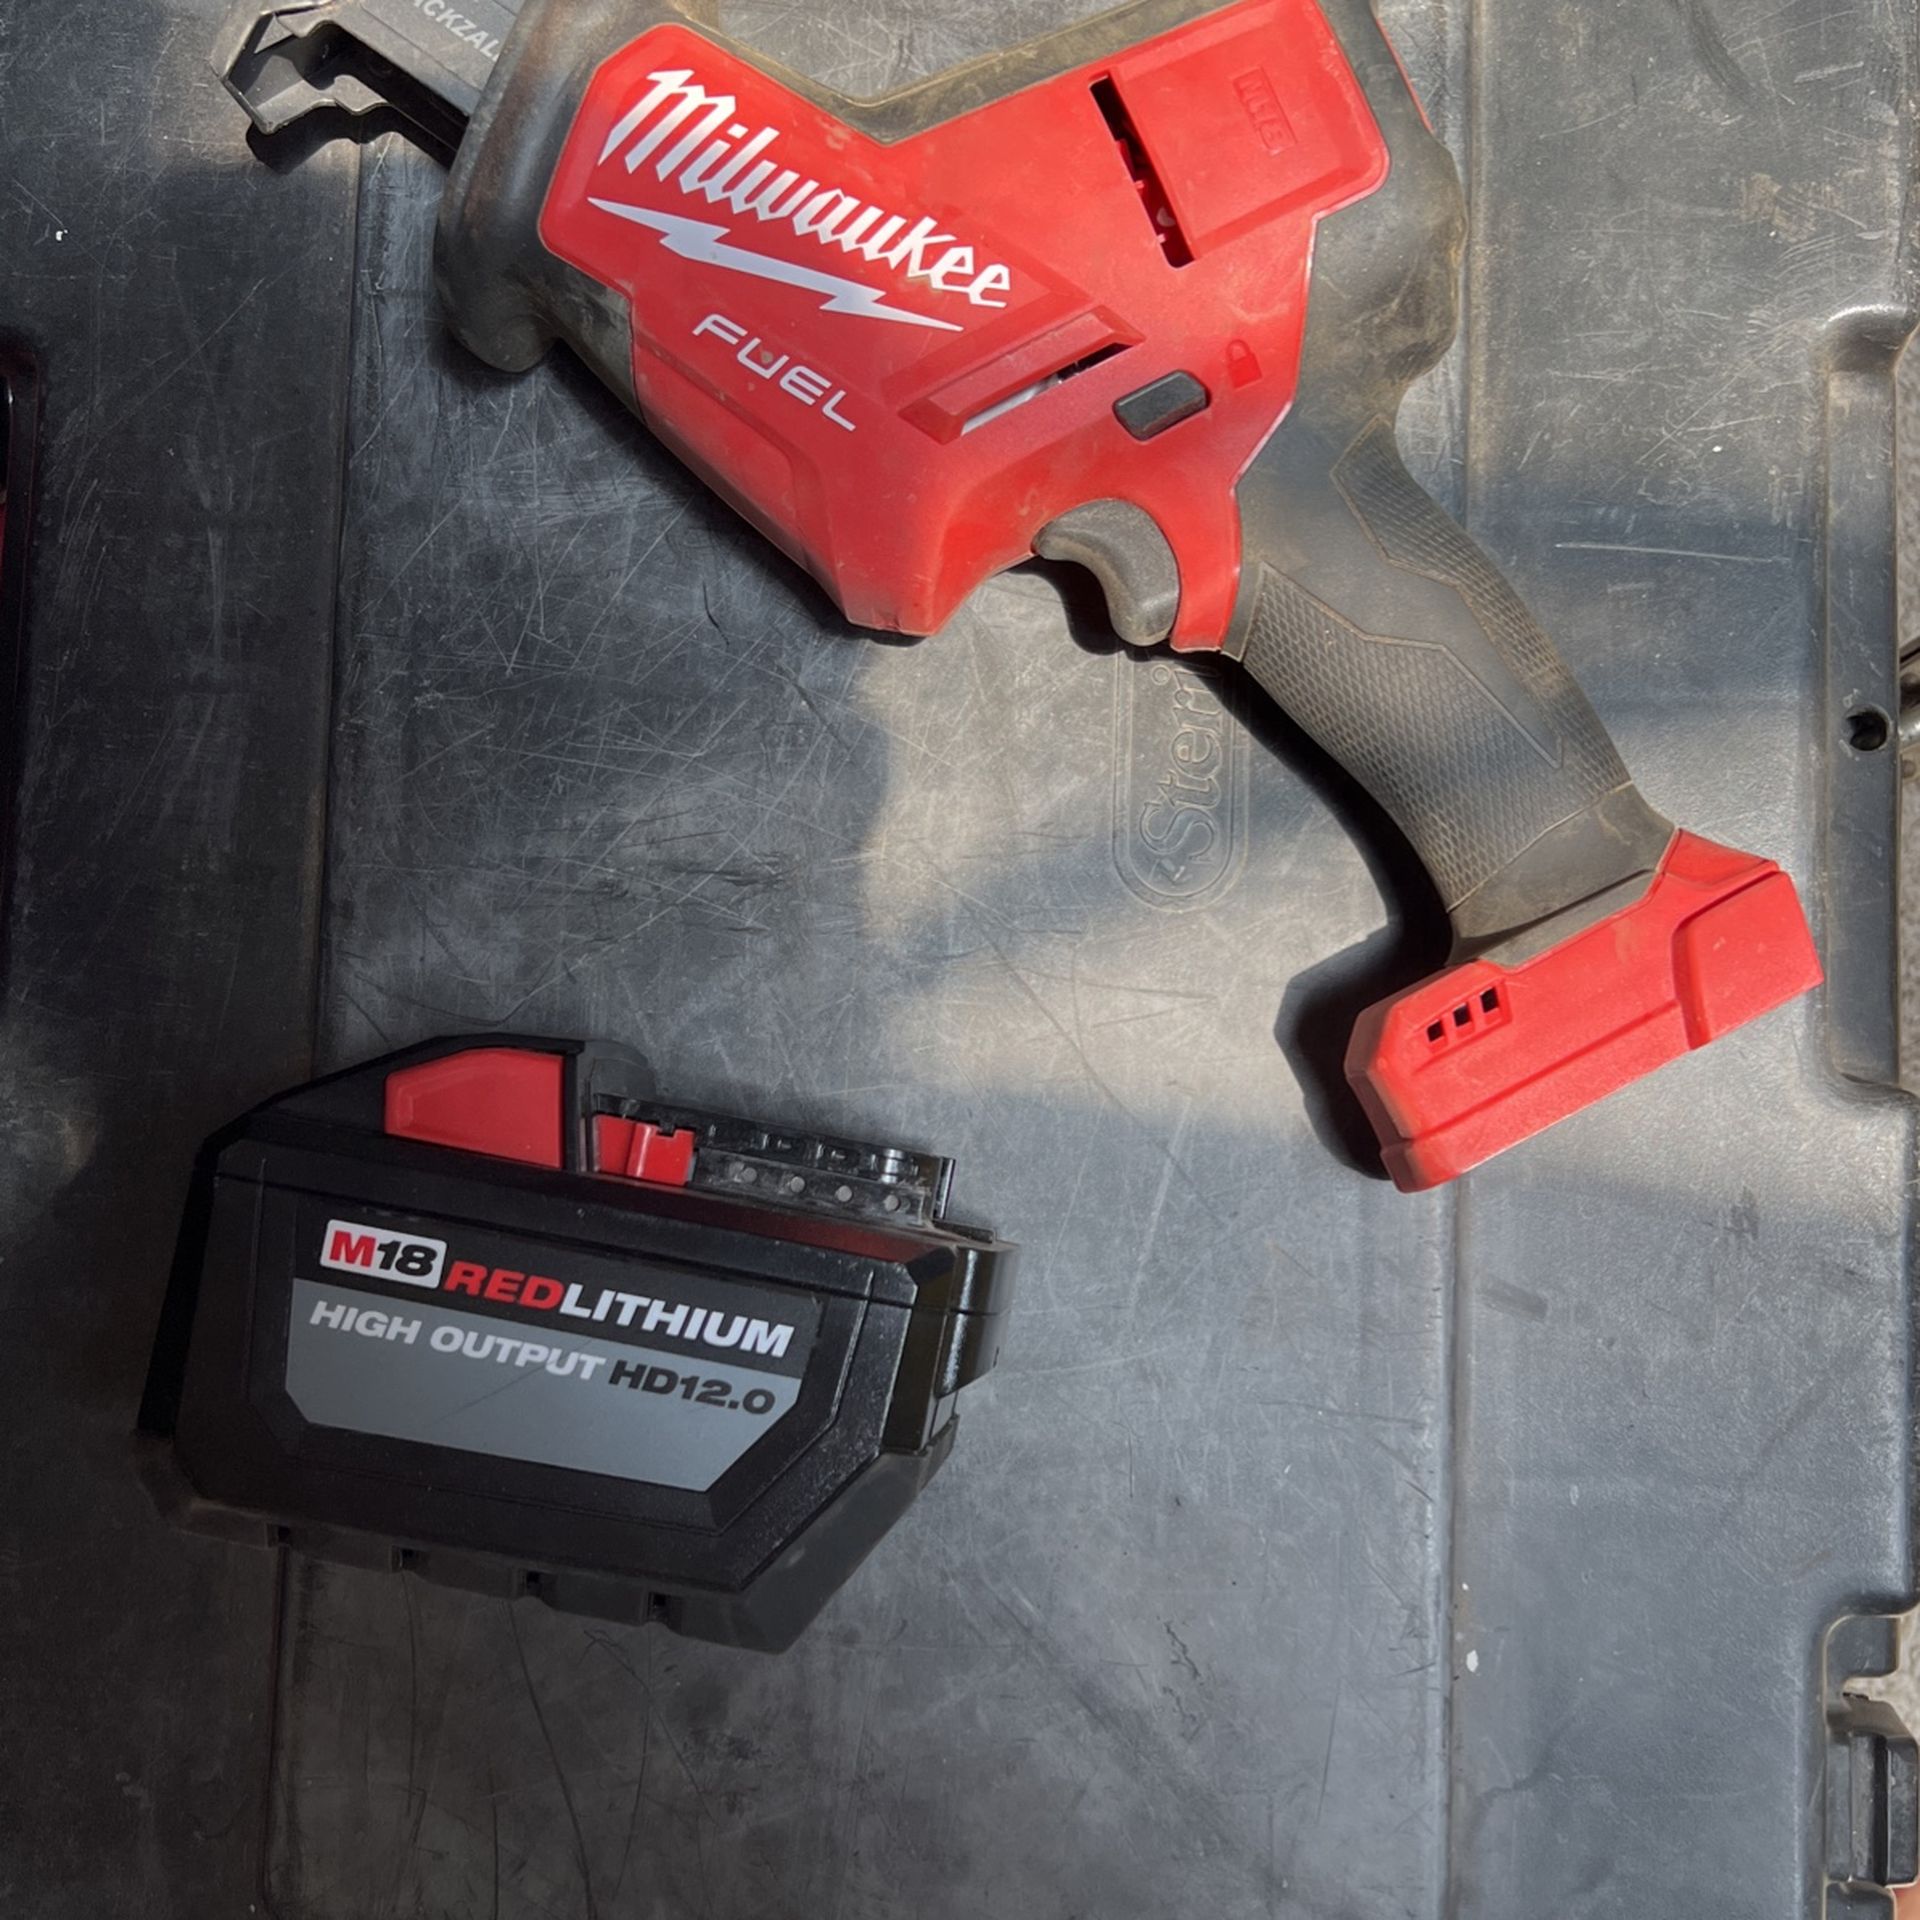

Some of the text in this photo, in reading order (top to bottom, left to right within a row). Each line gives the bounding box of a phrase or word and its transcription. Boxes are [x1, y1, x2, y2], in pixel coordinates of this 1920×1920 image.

[598, 69, 1011, 308] Milwaukee
[692, 313, 857, 432] FUEL
[327, 1230, 796, 1358] M18 REDLITHIUM
[308, 1300, 777, 1416] HIGH OUTPUT HD12.0
